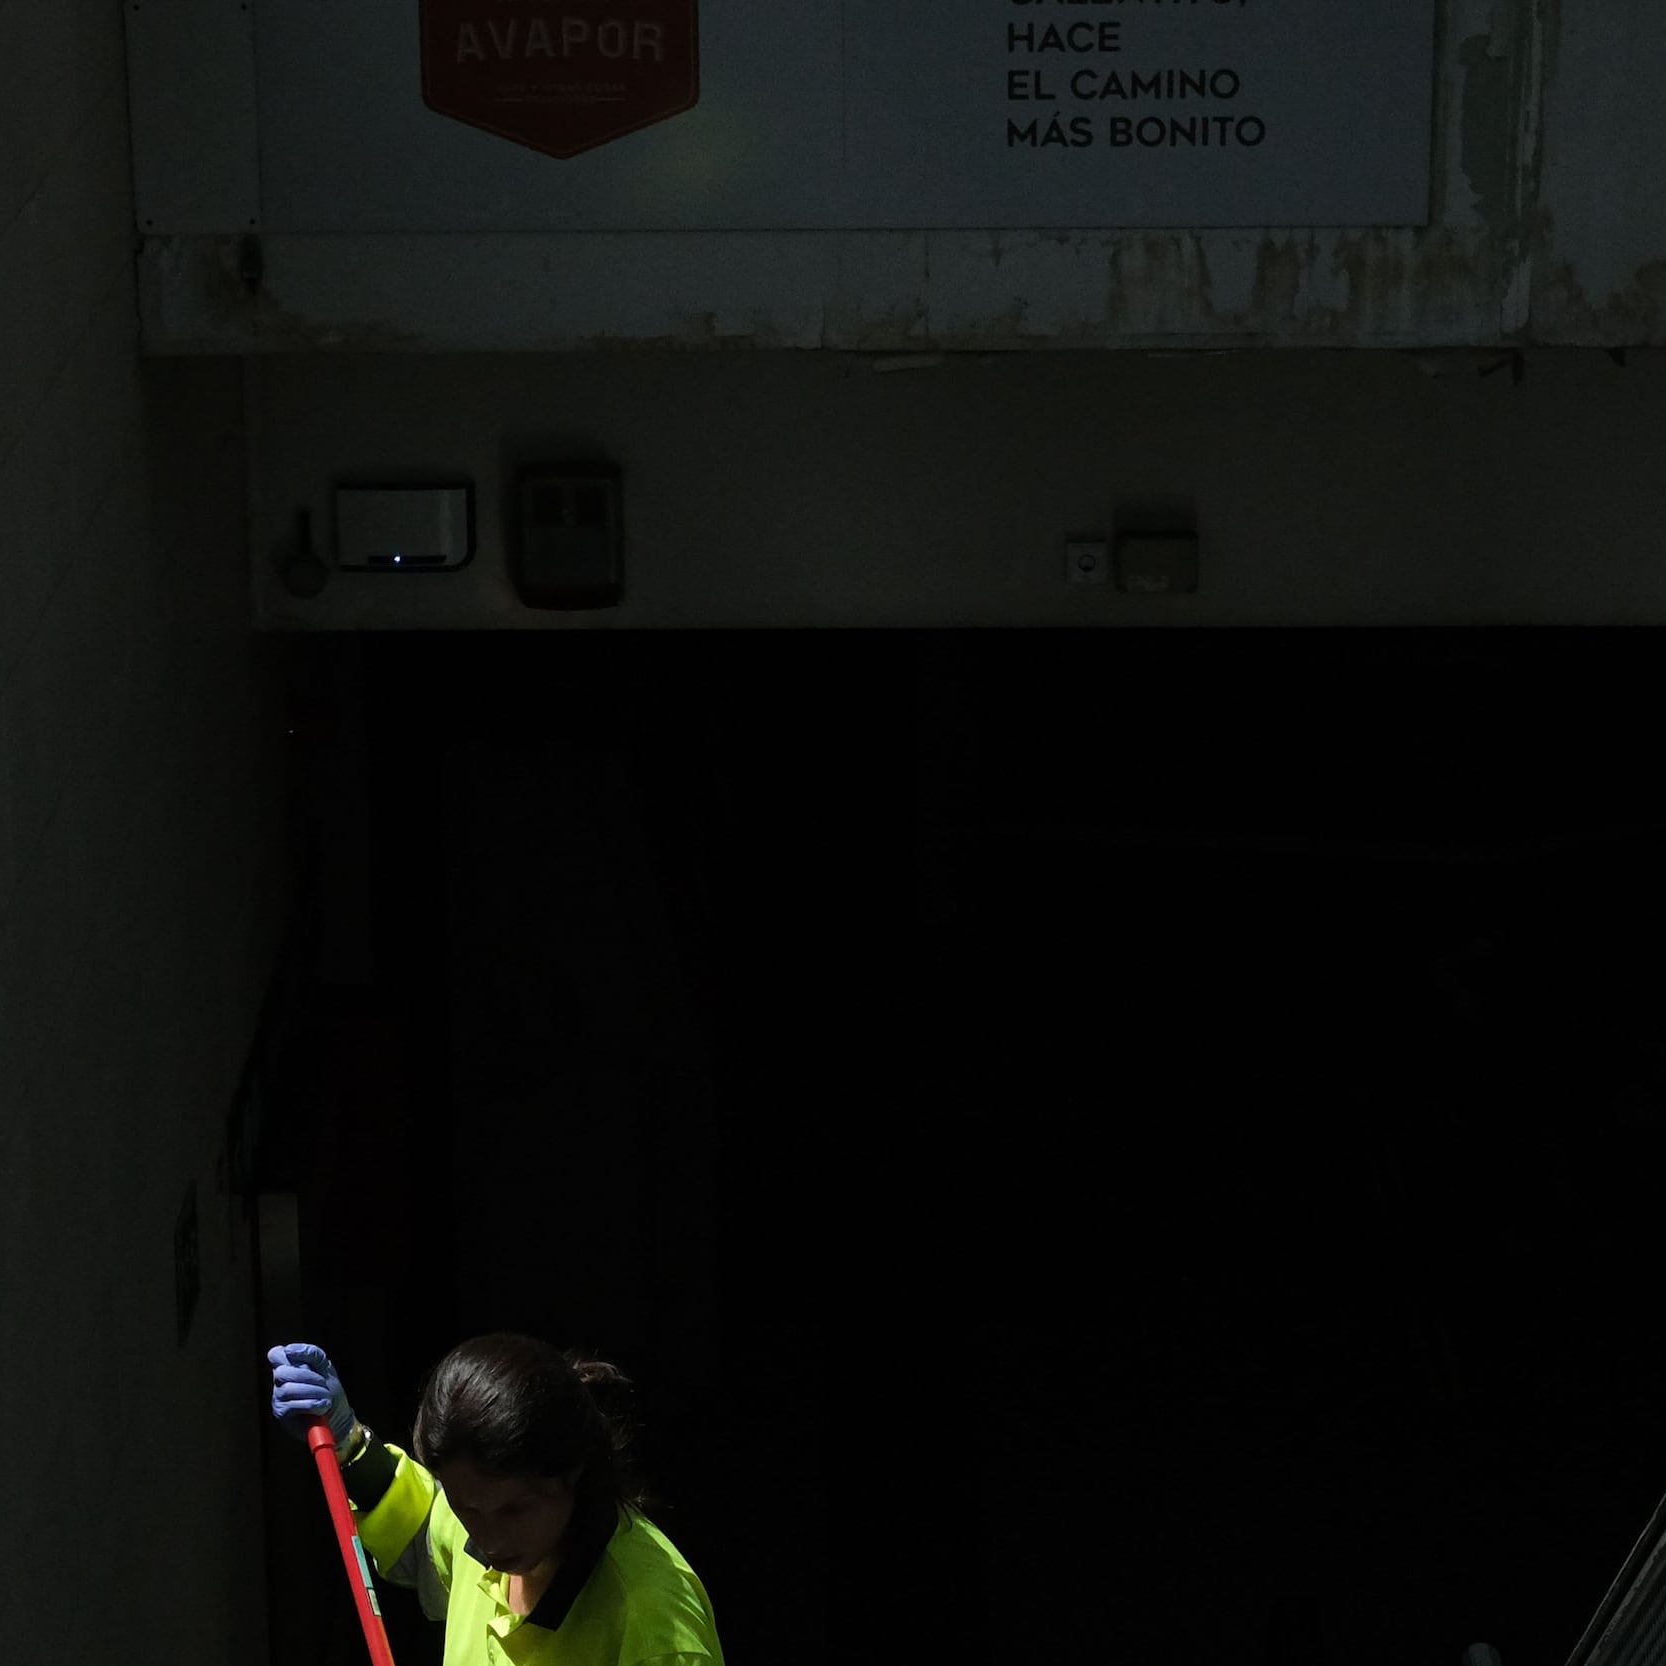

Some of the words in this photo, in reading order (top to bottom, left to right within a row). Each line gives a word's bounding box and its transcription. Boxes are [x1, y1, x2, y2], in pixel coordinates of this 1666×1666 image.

[456, 17, 665, 63] AVAPOR
[1008, 22, 1121, 52] HACE
[1007, 70, 1055, 100] EL
[1070, 69, 1240, 100] CAMINO
[1007, 111, 1094, 147] MÁS
[1110, 116, 1265, 147] BONITO
